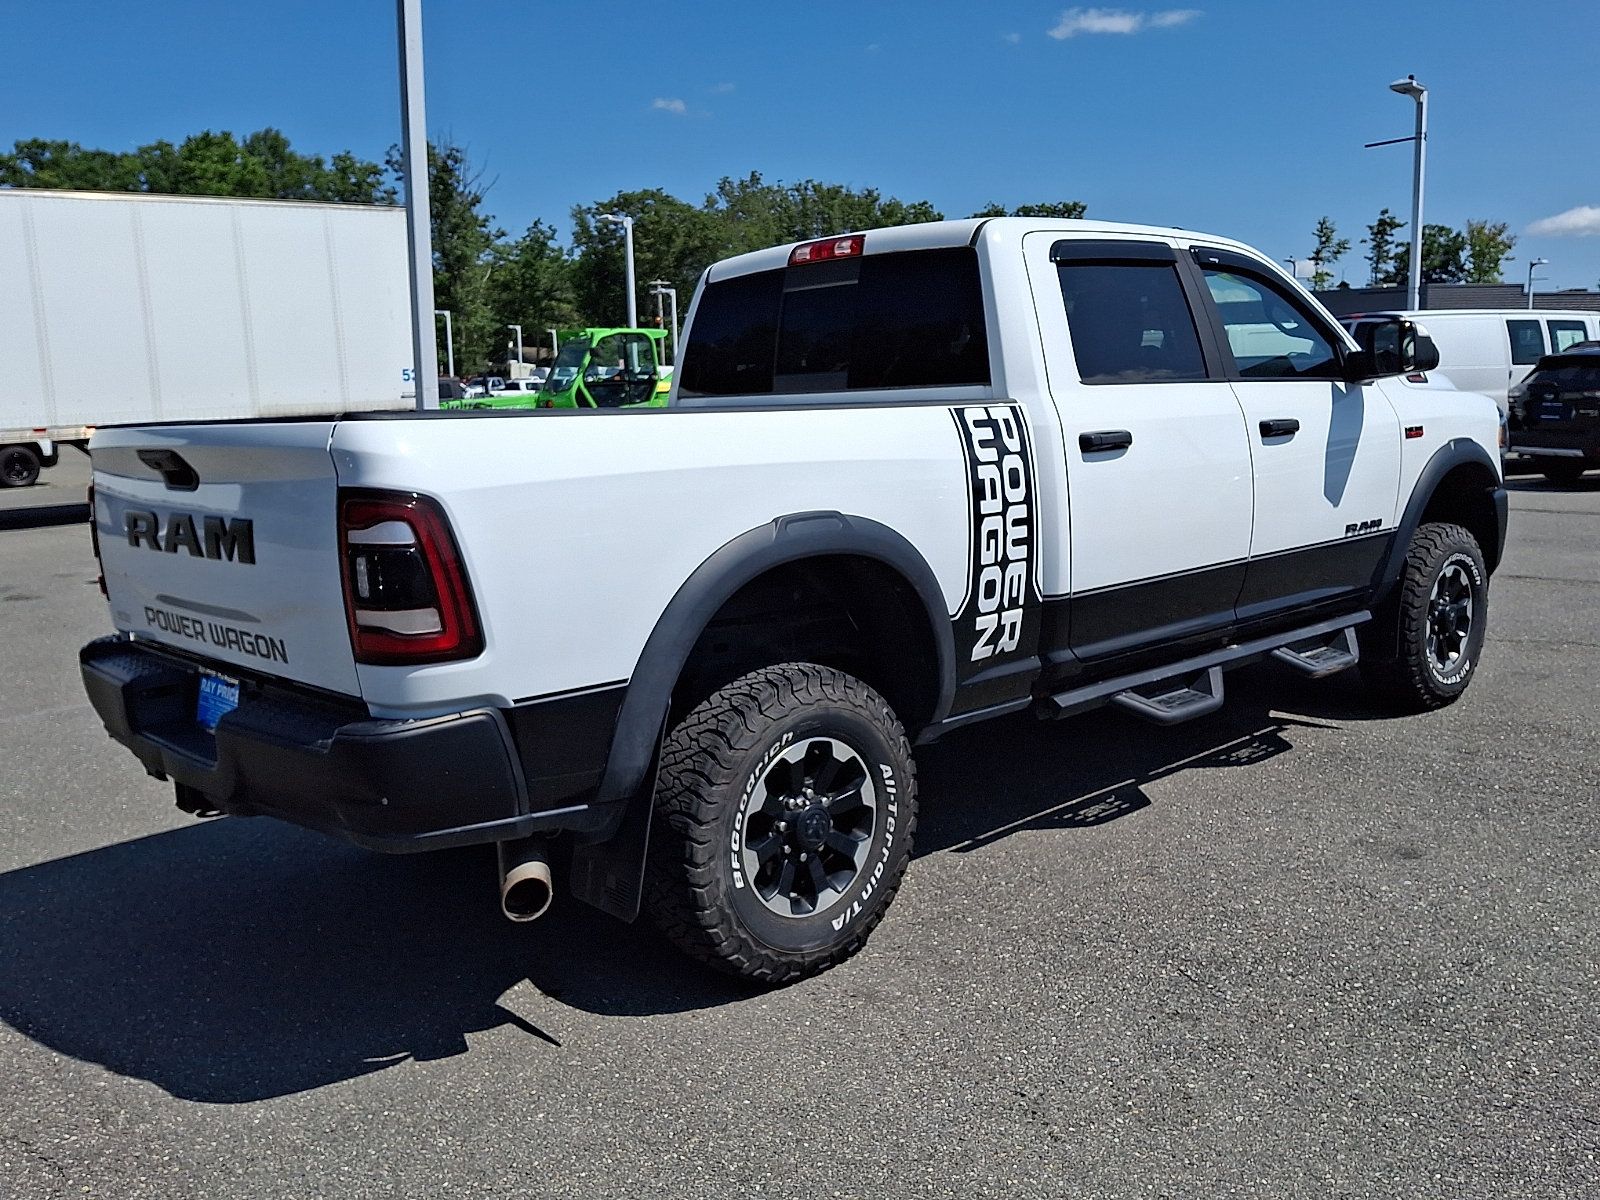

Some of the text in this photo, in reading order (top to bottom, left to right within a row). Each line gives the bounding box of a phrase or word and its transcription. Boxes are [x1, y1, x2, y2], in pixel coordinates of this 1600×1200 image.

[125, 511, 256, 565] RAM
[964, 407, 1003, 661] WAGON
[990, 406, 1027, 655] POWER
[1345, 518, 1383, 536] RAM
[144, 606, 289, 664] POWER WAGON
[731, 731, 794, 889] BFGoodrich
[831, 763, 898, 931] All-Terrain T/A
